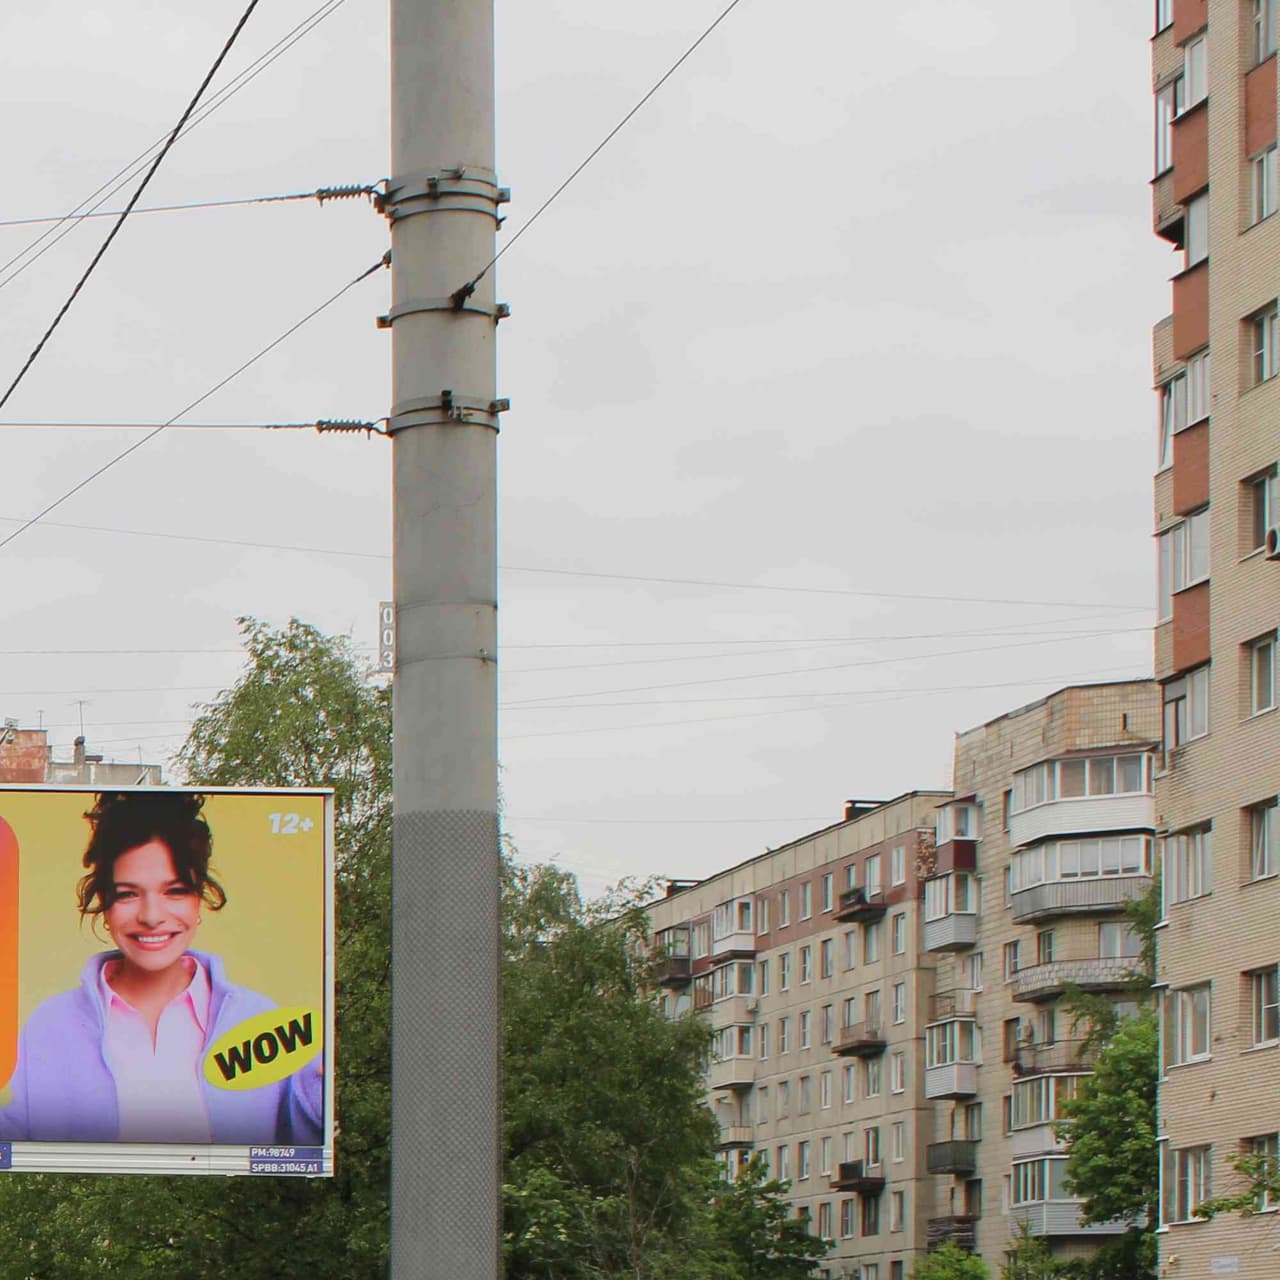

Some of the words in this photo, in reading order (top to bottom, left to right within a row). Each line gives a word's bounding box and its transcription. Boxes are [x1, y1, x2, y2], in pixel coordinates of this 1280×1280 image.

[268, 812, 315, 834] 12+
[213, 1012, 313, 1082] WOW
[307, 1164, 318, 1172] A1
